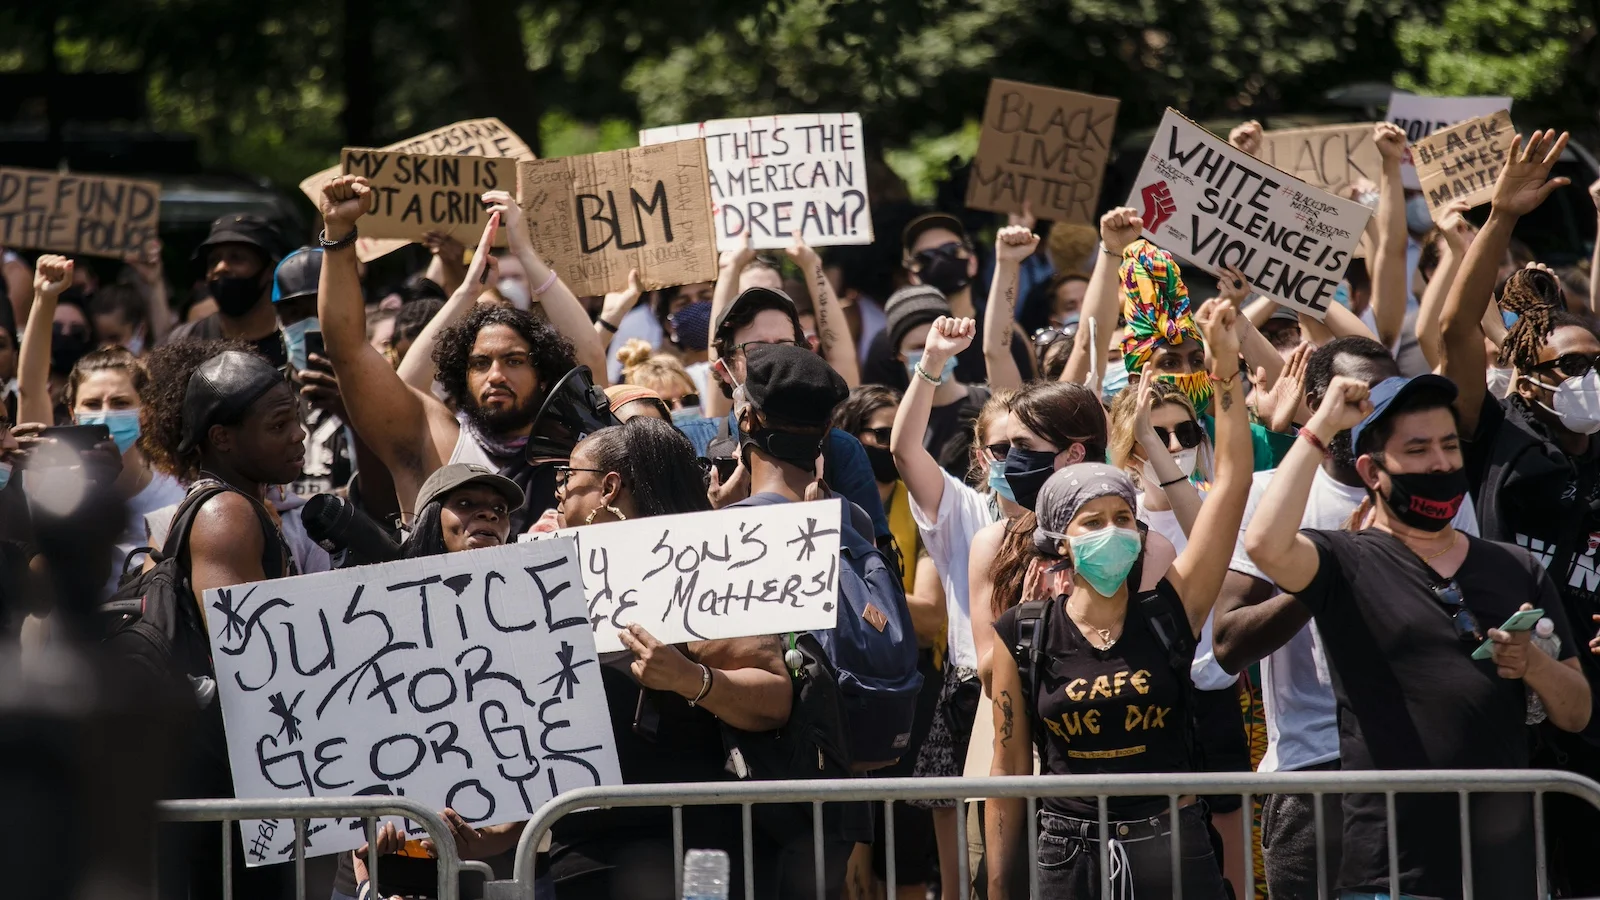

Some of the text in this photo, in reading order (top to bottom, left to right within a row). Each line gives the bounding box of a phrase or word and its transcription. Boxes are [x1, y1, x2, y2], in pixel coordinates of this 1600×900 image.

[706, 124, 856, 162] THIS THE
[989, 91, 1113, 150] BLACK
[1418, 119, 1504, 165] BLACK
[346, 152, 498, 189] MY SKIN IS
[709, 161, 853, 198] AMERICAN
[1168, 125, 1281, 213] WHITE
[1441, 140, 1504, 177] LIVES
[0, 172, 155, 222] DEFUND
[367, 186, 401, 216] OT
[401, 193, 423, 225] A
[970, 162, 1093, 222] MATTER
[1429, 160, 1507, 208] MATTE
[0, 210, 73, 248] THE
[576, 179, 674, 255] BLM
[721, 189, 866, 239] DREAM?
[1197, 187, 1348, 272] SILENCE IS
[1191, 214, 1339, 313] VIOLENCE
[642, 522, 768, 581] SON'S
[317, 641, 536, 721] FOR
[1064, 669, 1152, 702] CAFE
[256, 696, 603, 797] GEORGE
[1043, 704, 1172, 743] RUE DIX
